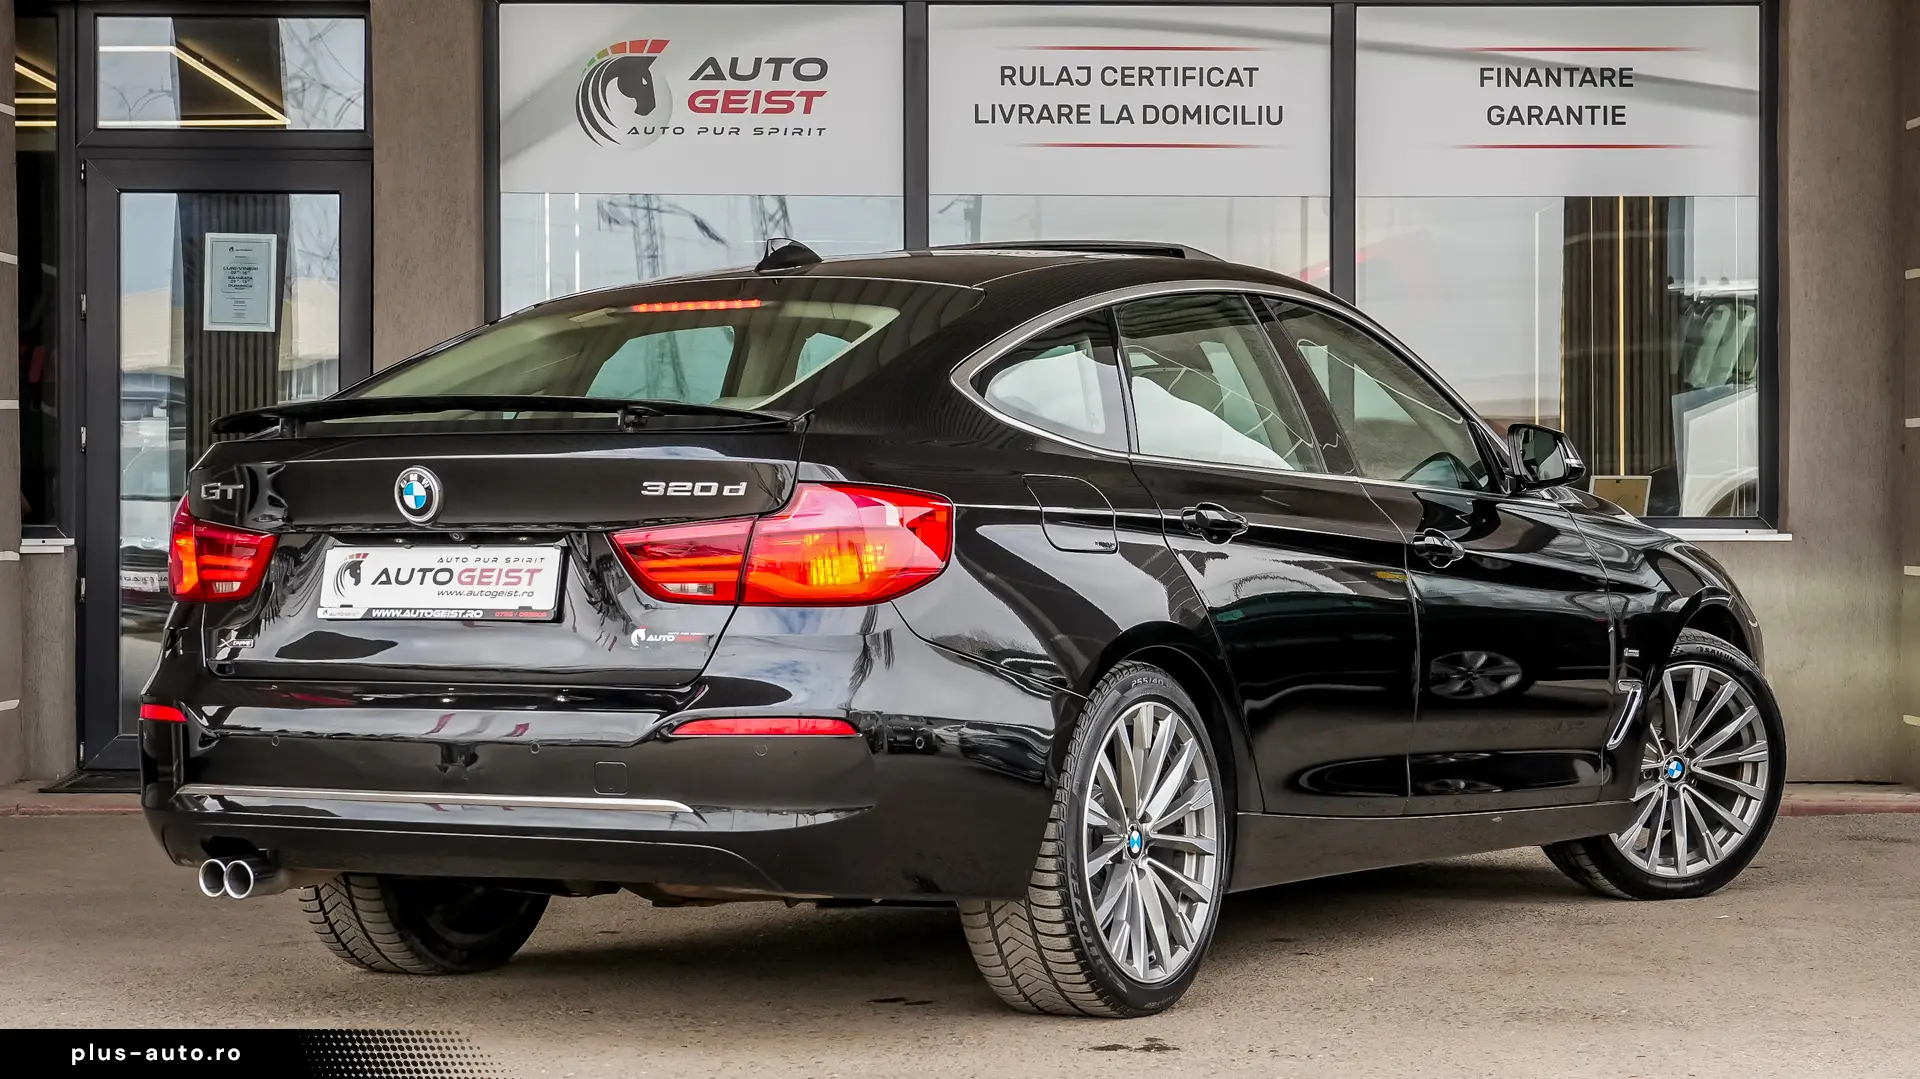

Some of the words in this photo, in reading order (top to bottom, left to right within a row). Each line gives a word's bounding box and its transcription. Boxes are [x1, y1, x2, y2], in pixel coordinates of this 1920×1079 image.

[688, 57, 829, 82] AUTO
[1000, 65, 1092, 88] RULAJ
[1100, 65, 1260, 88] CERTIFICAT
[1479, 66, 1634, 88] FINANTARE
[687, 90, 828, 115] GEIST
[974, 104, 1091, 126] LIVRARE
[1101, 104, 1135, 126] LA
[1142, 104, 1284, 126] DOMICILIU
[1486, 105, 1627, 127] GARANTIE
[626, 126, 685, 137] AUTO
[697, 126, 741, 137] PUR
[752, 126, 827, 137] SPIRIT
[201, 482, 244, 499] GT
[437, 588, 535, 599] www.autogeist.ro
[371, 609, 484, 619] WWW.AUTOGEIST.RO
